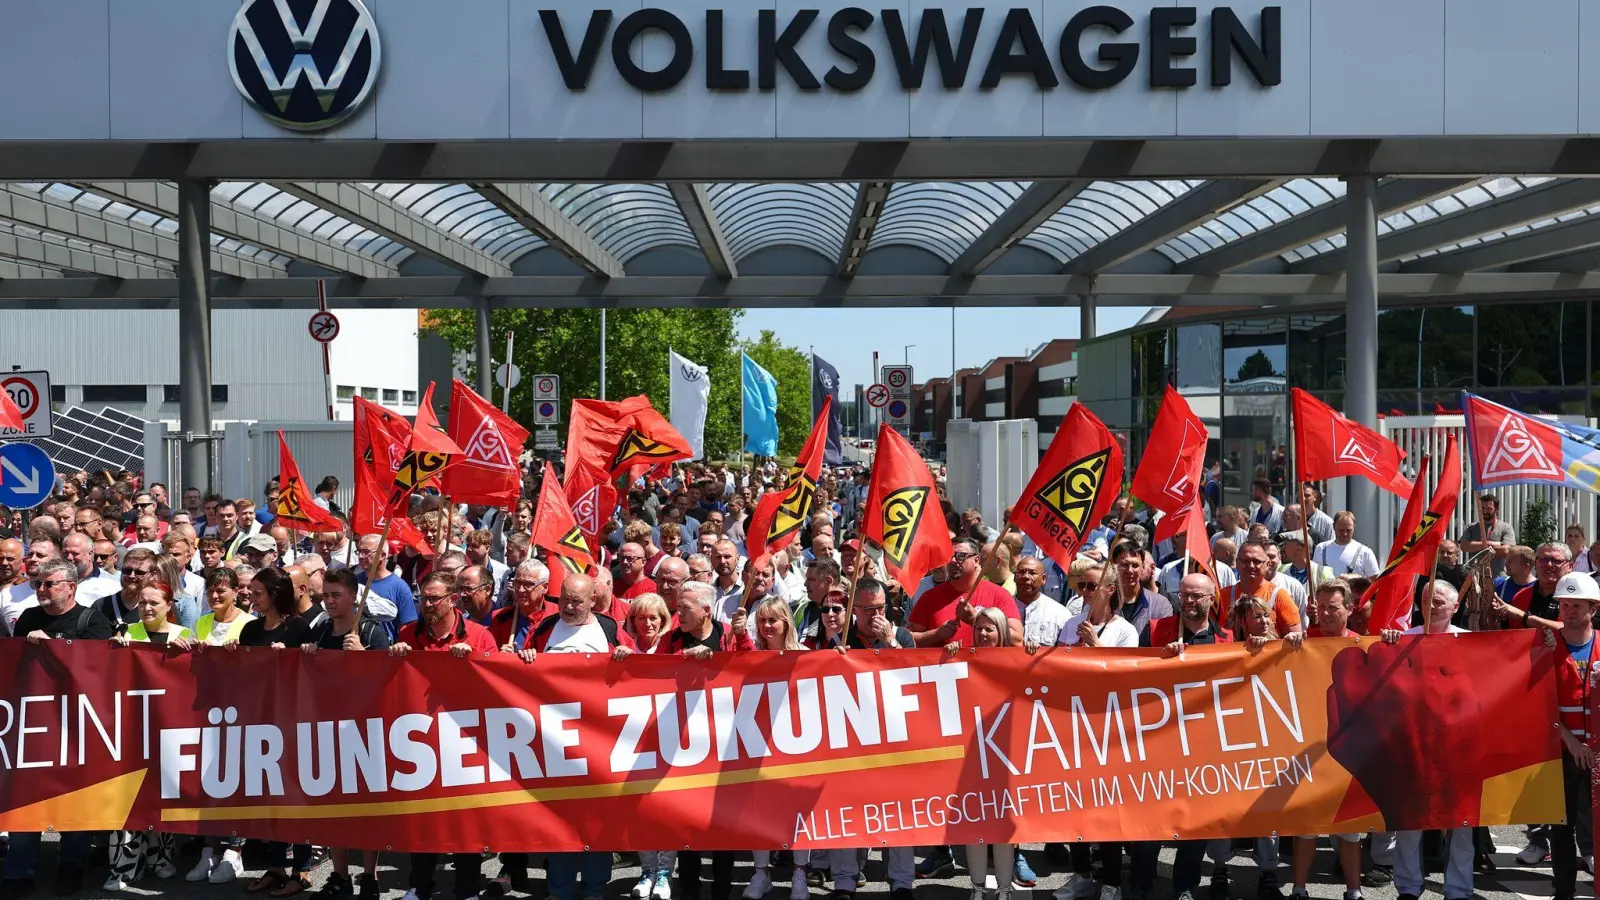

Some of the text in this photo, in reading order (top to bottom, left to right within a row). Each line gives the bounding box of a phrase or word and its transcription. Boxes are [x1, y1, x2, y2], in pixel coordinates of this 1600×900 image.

[540, 6, 1281, 92] VOLKSWAGEN
[892, 374, 903, 383] 30
[1024, 498, 1078, 557] IG Metall
[160, 706, 284, 799] FÜR
[297, 702, 588, 796] UNSERE
[607, 661, 969, 773] ZUKUNFT
[973, 670, 1304, 779] KÄMPFEN
[793, 754, 1313, 843] ALLE BELEGSCHAFTEN IM VW-KONZERN
